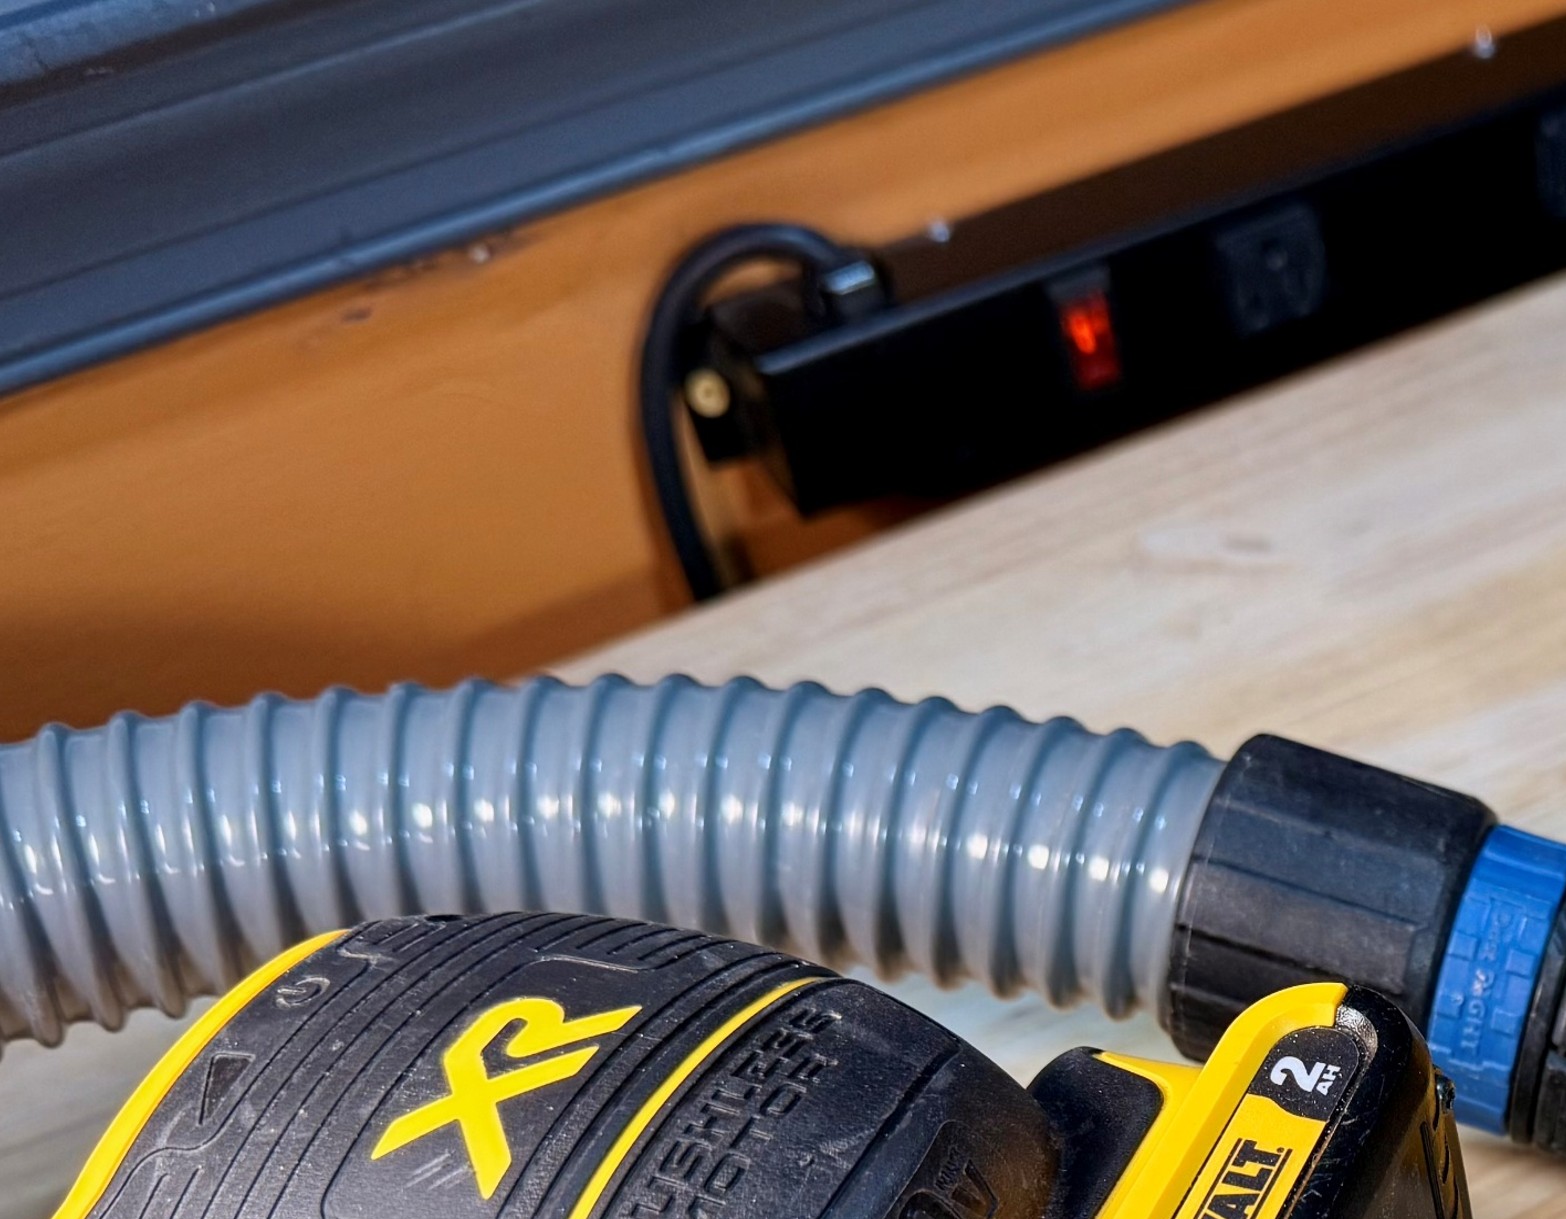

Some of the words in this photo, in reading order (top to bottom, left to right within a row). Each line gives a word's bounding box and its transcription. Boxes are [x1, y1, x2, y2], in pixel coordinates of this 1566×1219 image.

[371, 997, 643, 1200] XR
[1270, 1055, 1322, 1093] 2
[1315, 1064, 1341, 1097] AH
